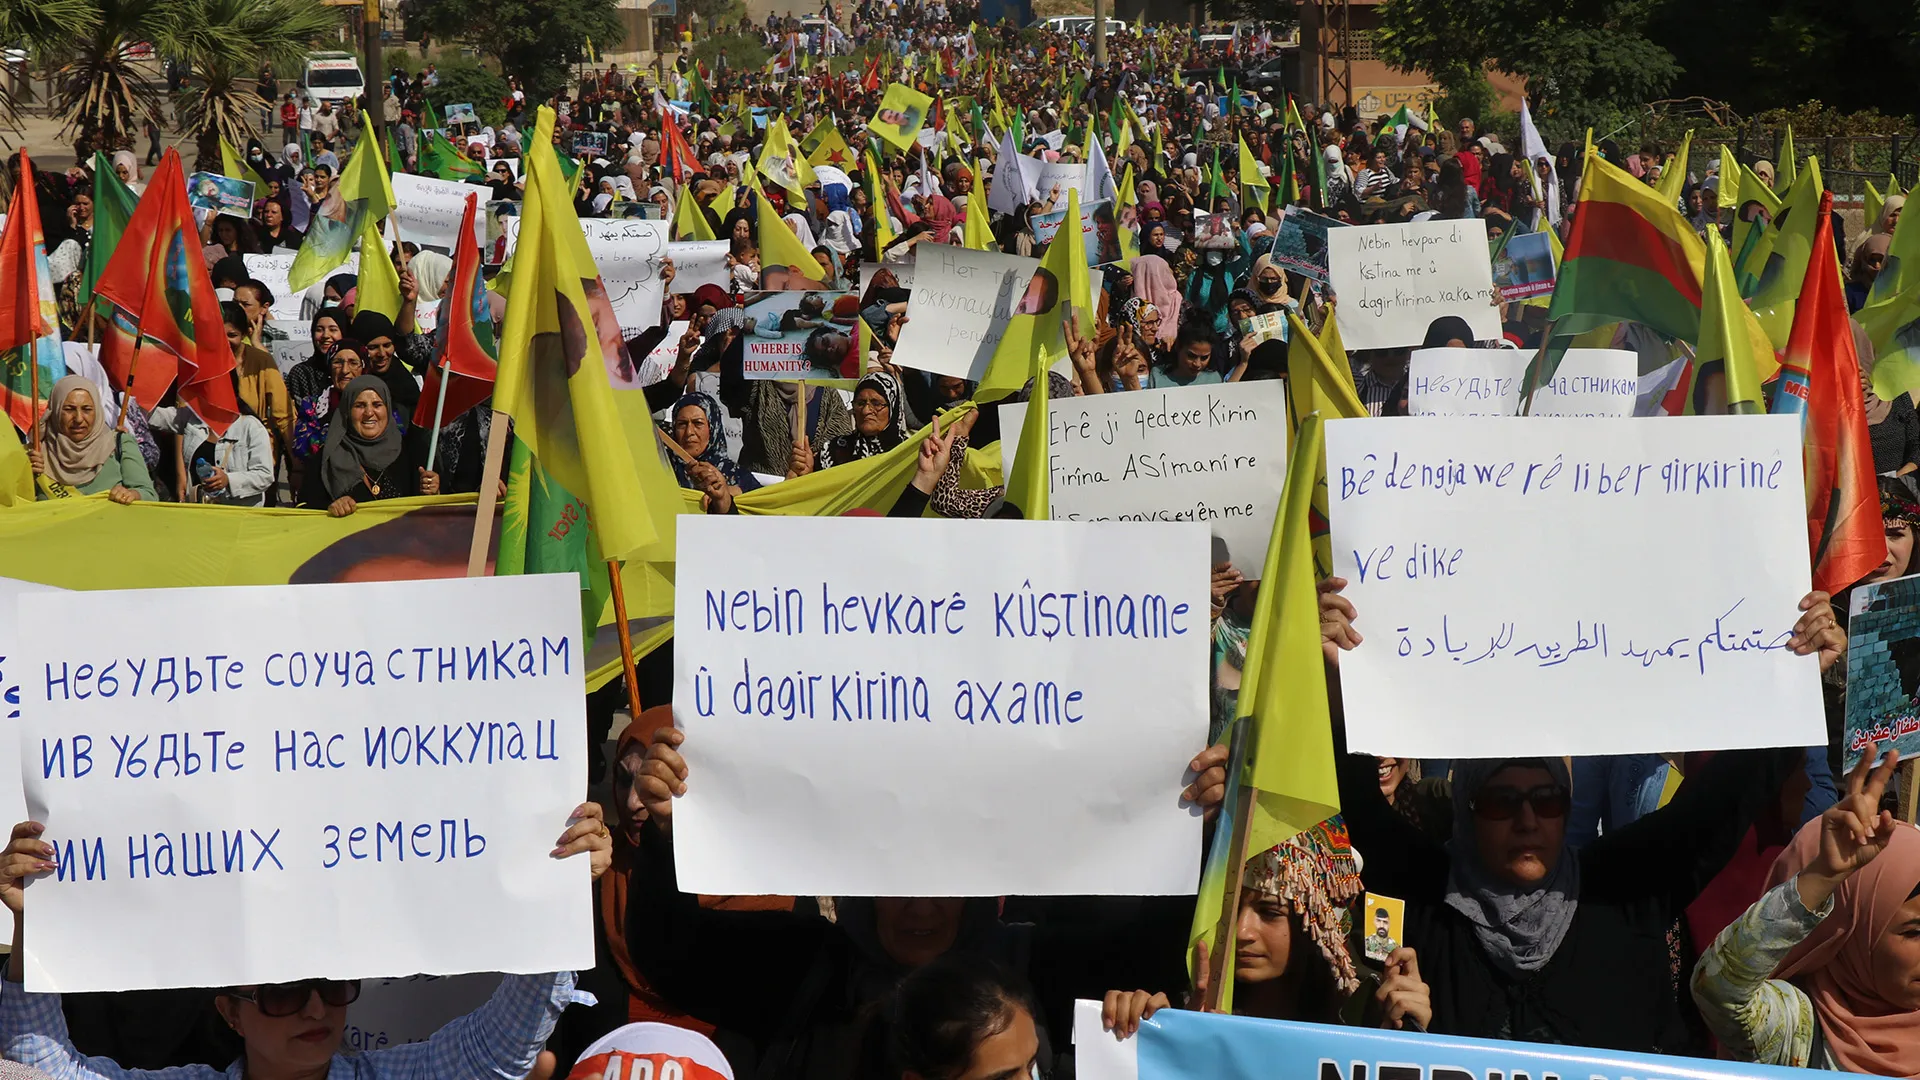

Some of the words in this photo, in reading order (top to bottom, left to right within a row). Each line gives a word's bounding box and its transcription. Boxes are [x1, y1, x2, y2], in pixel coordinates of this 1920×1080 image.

[1358, 231, 1391, 252] Nebin
[1401, 228, 1443, 252] hevpar
[1450, 225, 1462, 243] di
[942, 252, 979, 278] Нет
[1407, 266, 1421, 276] me
[751, 343, 789, 354] WHERE
[792, 343, 802, 354] IS
[1050, 411, 1091, 446] Erê
[1101, 413, 1119, 445] ji
[1050, 454, 1110, 494] Firîna
[1341, 454, 1377, 501] Bê
[1522, 454, 1563, 495] rê
[706, 586, 804, 636] Nebin
[694, 666, 716, 717] û
